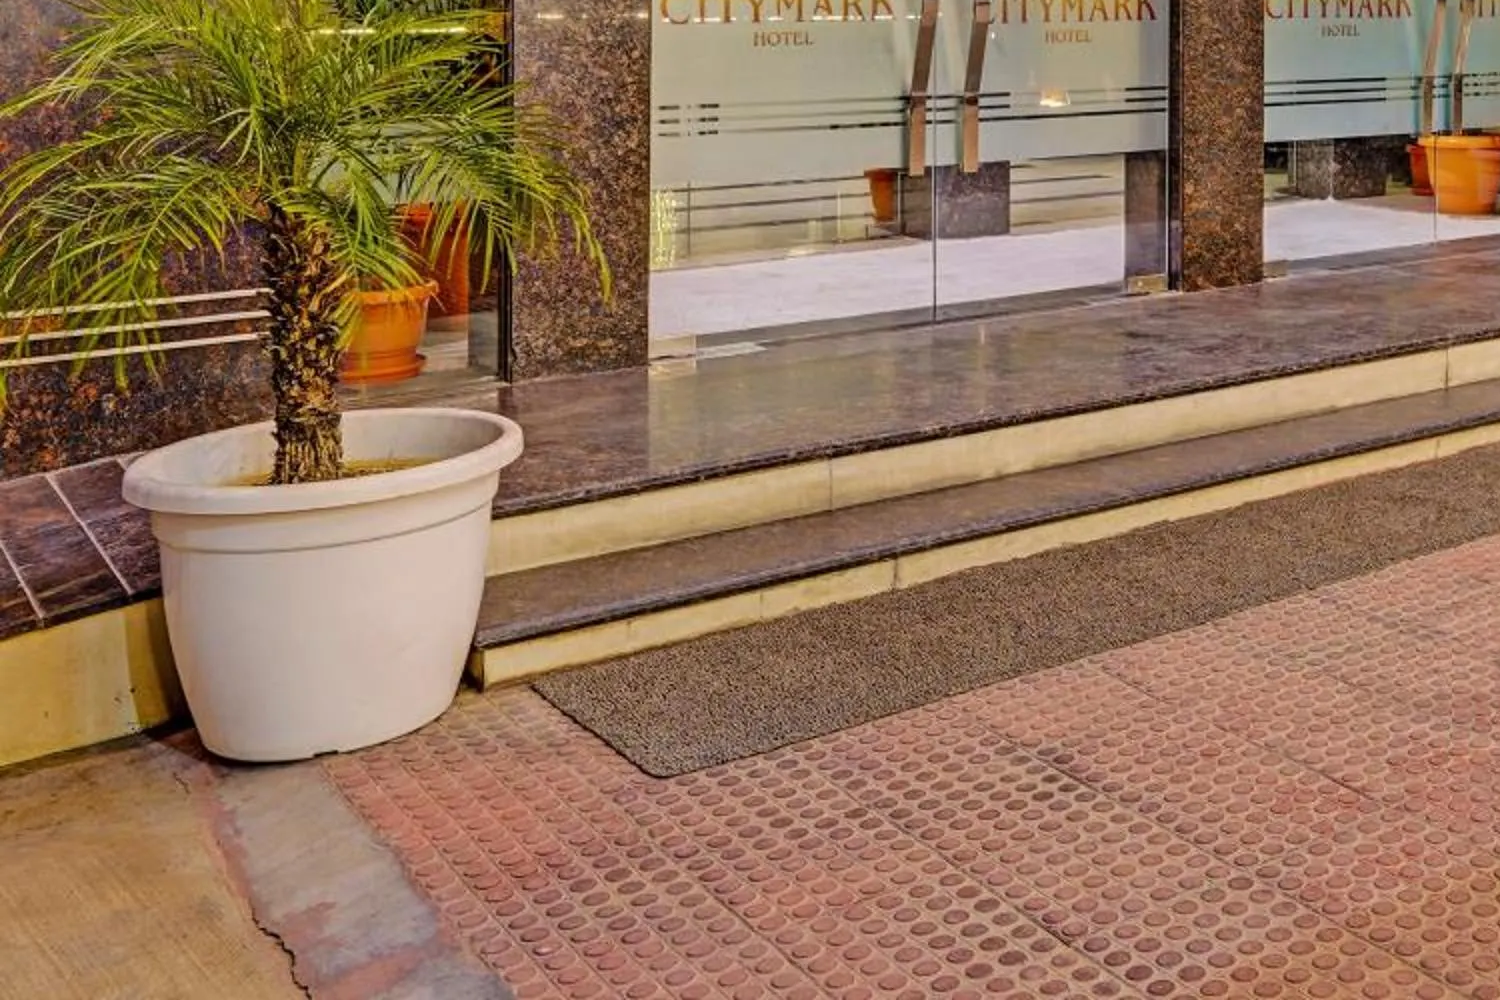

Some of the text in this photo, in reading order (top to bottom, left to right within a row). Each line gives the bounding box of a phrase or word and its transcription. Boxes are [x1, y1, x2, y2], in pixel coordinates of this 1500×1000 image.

[1045, 29, 1092, 44] HOTEL
[1321, 24, 1360, 37] HOTEL
[753, 31, 813, 47] HOTEL
